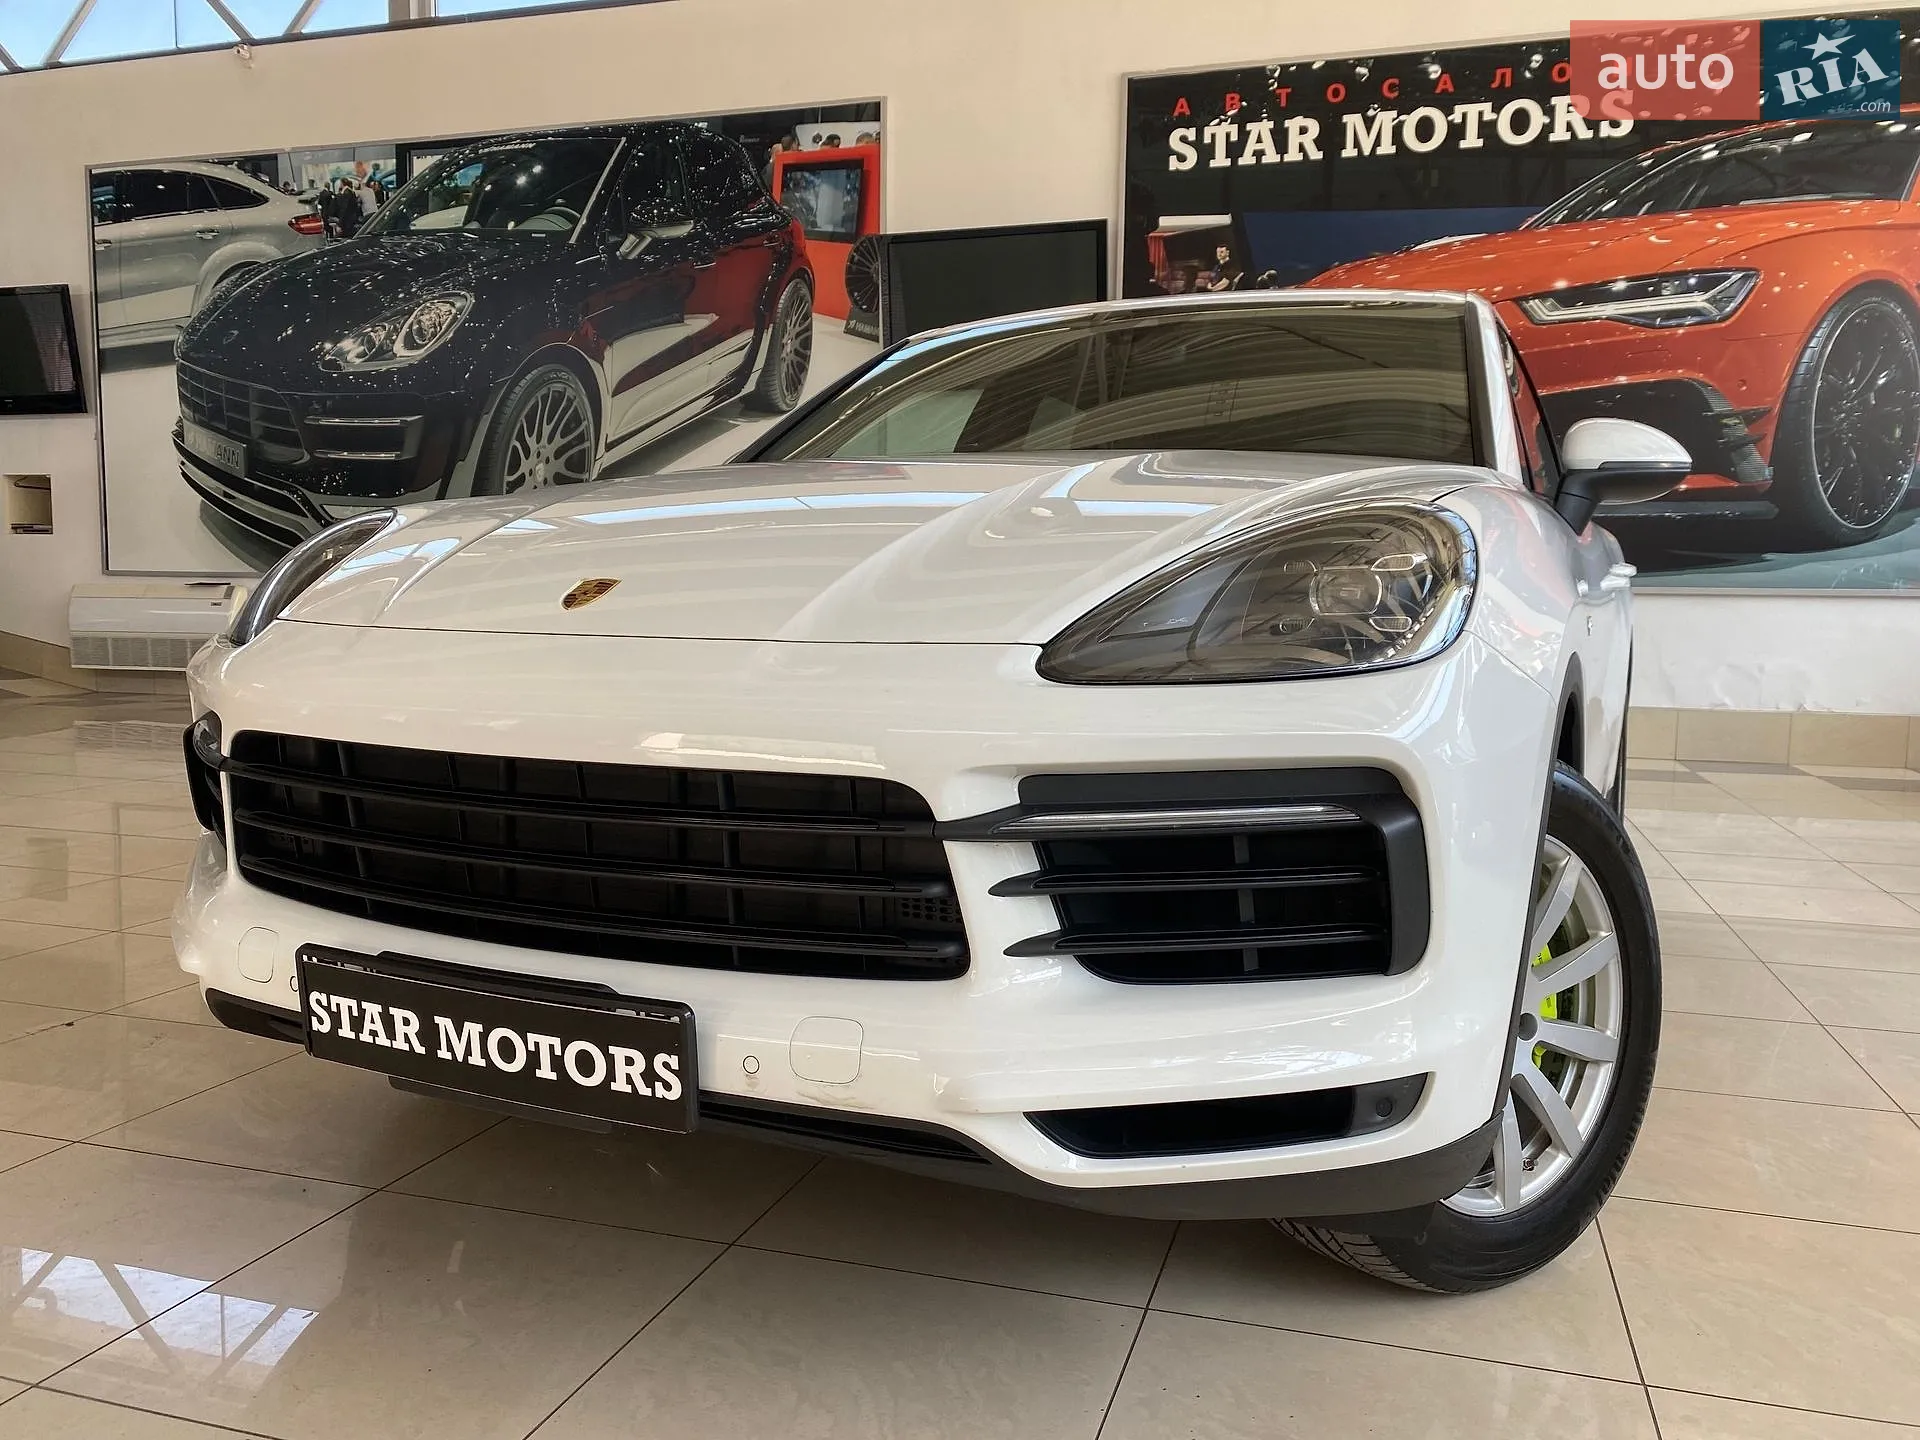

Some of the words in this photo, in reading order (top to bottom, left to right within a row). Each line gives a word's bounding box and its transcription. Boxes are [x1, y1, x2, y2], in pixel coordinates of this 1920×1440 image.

[1168, 115, 1323, 171] STAR
[1340, 88, 1634, 158] MOTORS
[308, 990, 426, 1055] STAR
[433, 1015, 683, 1101] MOTORS
